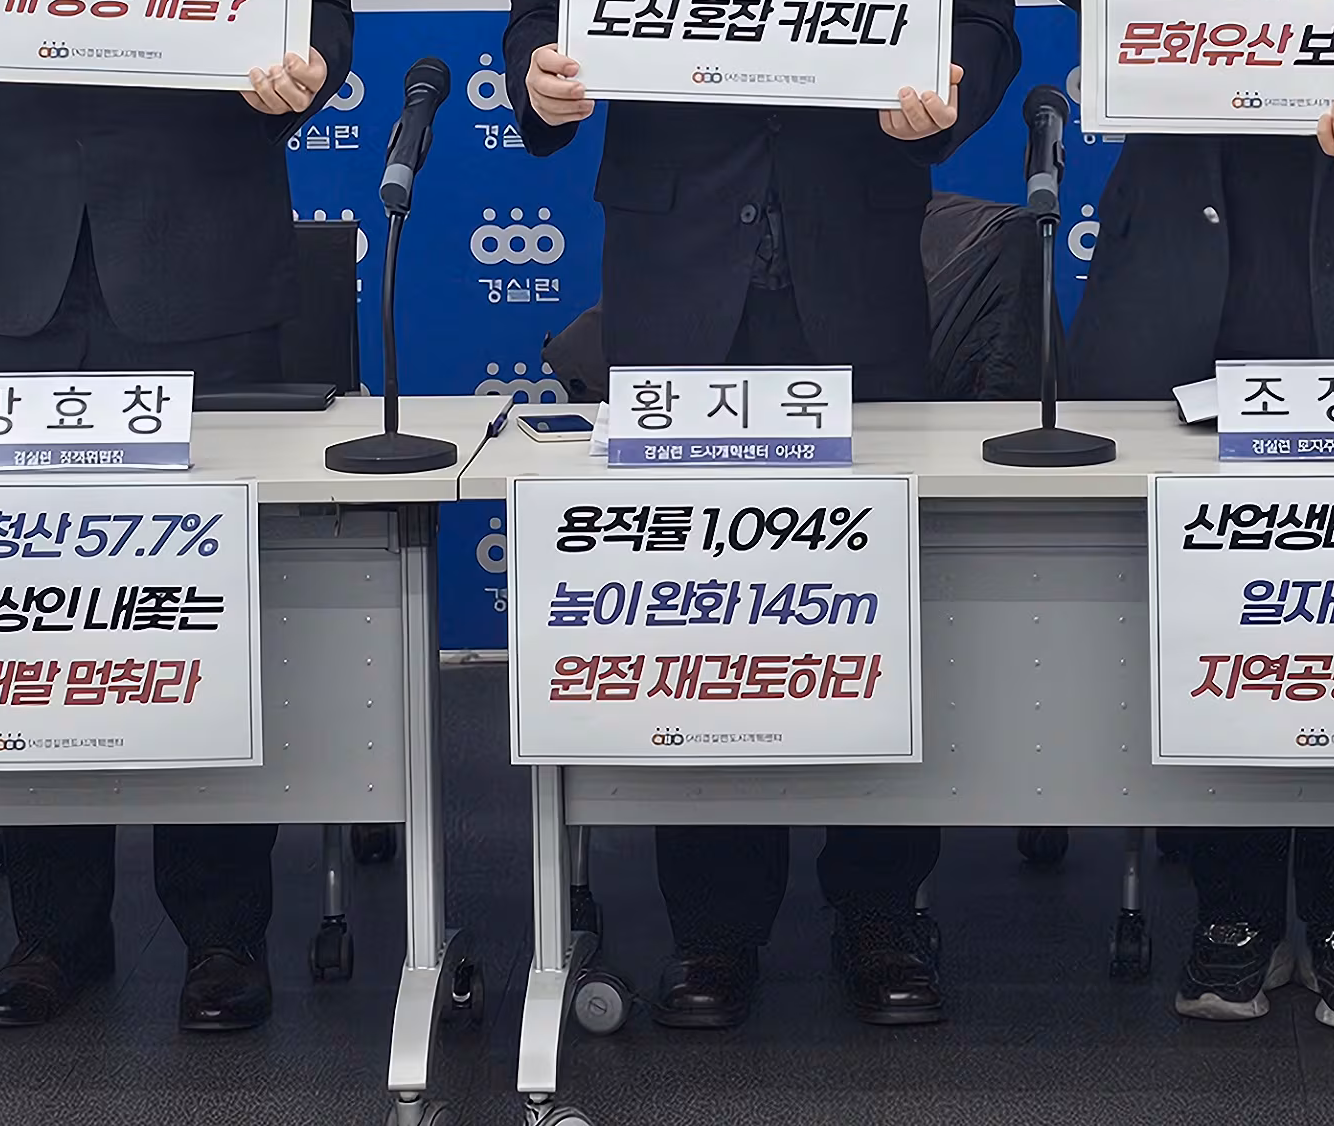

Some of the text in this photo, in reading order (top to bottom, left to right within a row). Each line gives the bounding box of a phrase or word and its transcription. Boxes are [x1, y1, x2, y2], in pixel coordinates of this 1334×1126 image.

[778, 0, 909, 47] 커진다
[1117, 20, 1295, 67] 문화유산
[478, 277, 560, 304] 경실련
[74, 513, 224, 558] 57.7%
[556, 505, 873, 558] 용적률 1,094%
[82, 585, 225, 631] 내쫓는
[547, 580, 644, 627] 높이
[645, 578, 742, 627] 완화
[748, 582, 879, 626] 145m
[63, 658, 203, 706] 멈춰라
[549, 653, 883, 701] 원점 재검토하라
